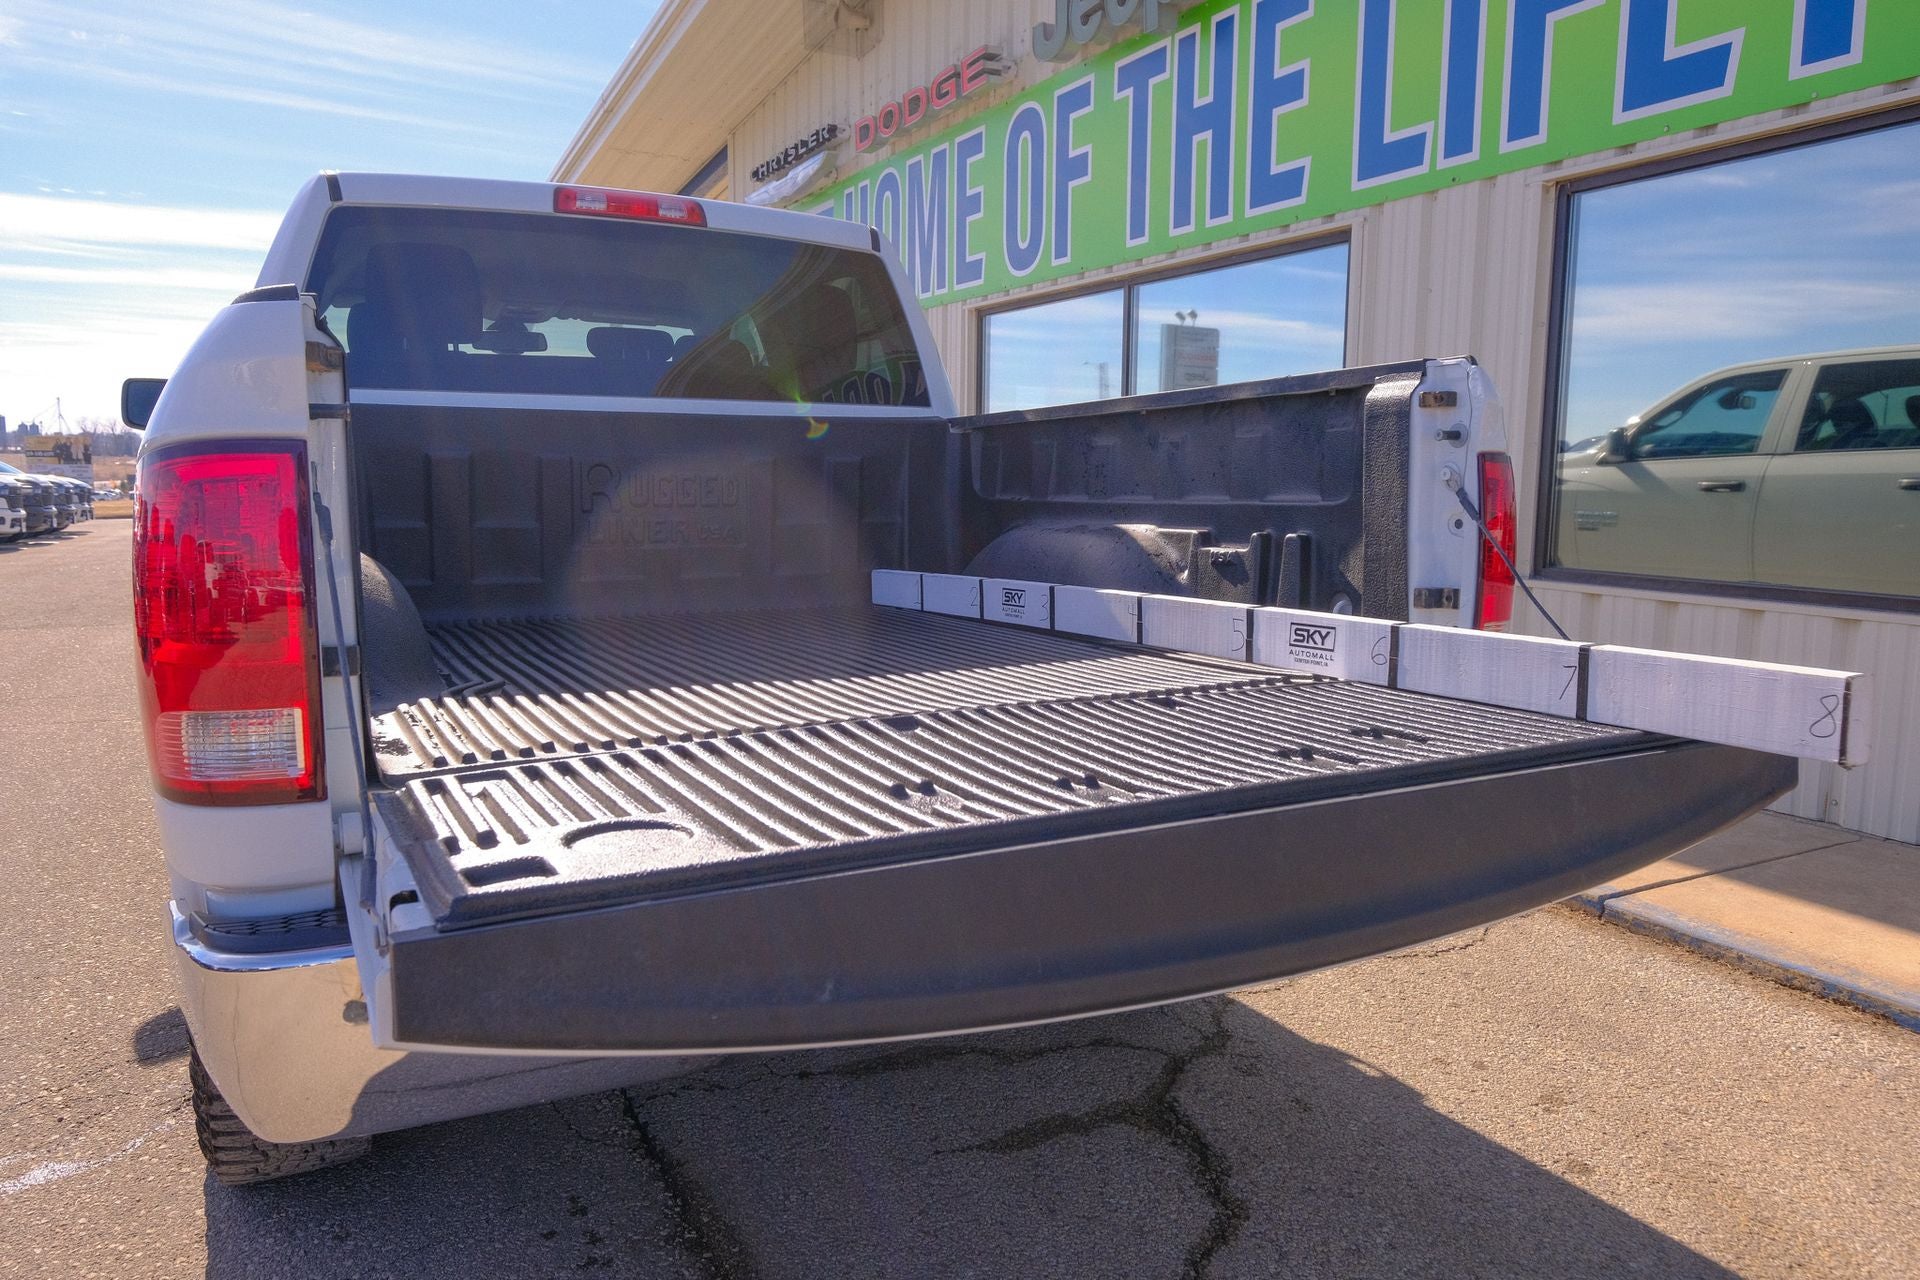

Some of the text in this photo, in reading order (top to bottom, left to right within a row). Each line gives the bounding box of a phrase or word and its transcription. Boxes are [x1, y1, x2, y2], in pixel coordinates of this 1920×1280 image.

[855, 46, 991, 152] DODGE
[751, 123, 837, 182] CHRYSLER
[1003, 73, 1096, 278] OF
[1114, 0, 1313, 248] THE
[579, 461, 739, 514] RUGGED
[968, 586, 979, 608] 2
[1003, 591, 1024, 605] SKY
[1039, 593, 1049, 622] 3
[1127, 603, 1137, 636] 4
[1231, 618, 1245, 652] 5
[1293, 627, 1331, 646] SKY
[1370, 636, 1388, 666] 6
[1289, 648, 1335, 661] AUTOMALL
[1559, 665, 1578, 701] 7
[1808, 694, 1840, 739] 8
